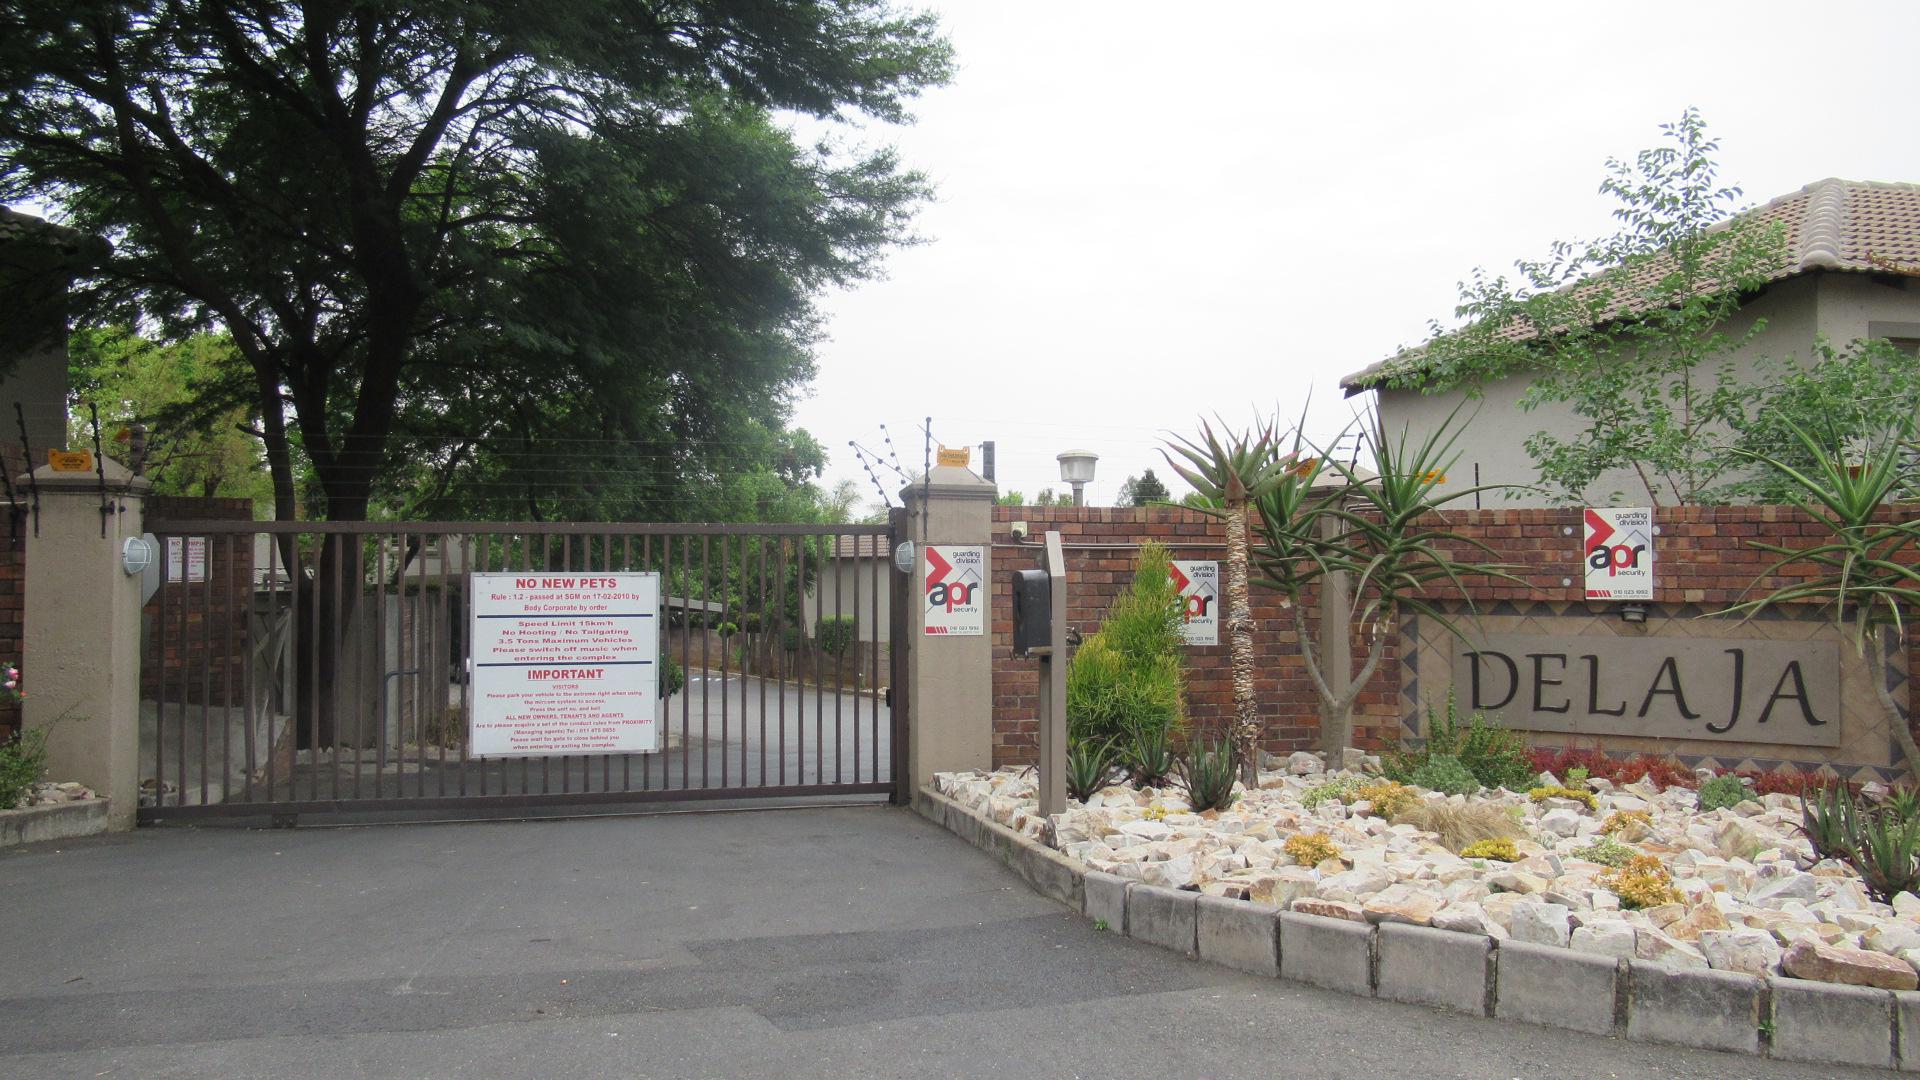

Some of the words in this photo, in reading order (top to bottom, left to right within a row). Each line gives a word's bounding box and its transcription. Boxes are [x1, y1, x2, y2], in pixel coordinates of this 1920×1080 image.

[1614, 512, 1648, 520] guarding
[1590, 544, 1646, 577] apr
[516, 578, 538, 589] NO
[542, 578, 576, 588] NEW
[580, 578, 617, 588] PETS
[490, 593, 507, 601] Rule
[529, 593, 554, 601] passed
[631, 593, 640, 601] by
[929, 582, 978, 613] apr
[524, 604, 542, 612] Body
[543, 604, 578, 612] Corporate
[579, 604, 588, 612] by
[527, 669, 604, 680] IMPORTANT
[1462, 648, 1827, 734] DELAJA
